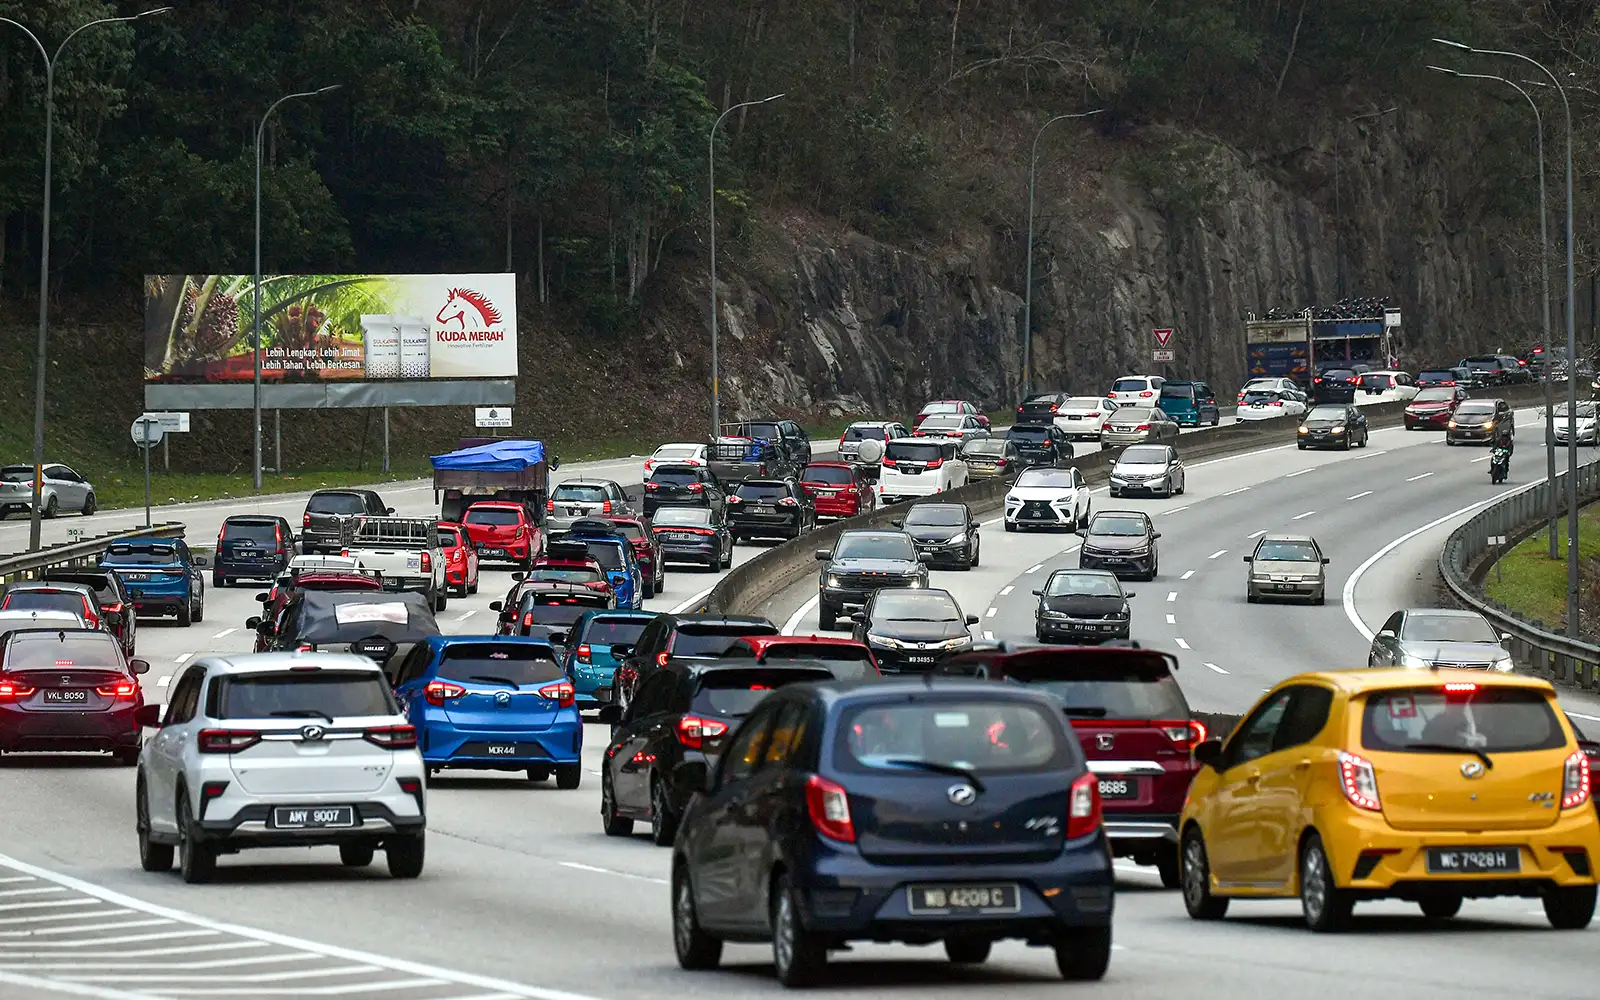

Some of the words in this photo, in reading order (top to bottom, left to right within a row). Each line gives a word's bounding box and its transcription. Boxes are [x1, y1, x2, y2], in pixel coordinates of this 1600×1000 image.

[436, 331, 467, 342] KUDA
[469, 331, 504, 341] MERAH
[266, 347, 285, 357] Lebih
[320, 347, 339, 357] Lebih
[341, 347, 361, 357] Jimat
[262, 360, 281, 370] Lebih
[306, 360, 326, 370] Lebih
[327, 360, 361, 369] Berkesan
[504, 746, 515, 754] 441
[1098, 780, 1127, 794] 8685
[289, 811, 307, 822] AMY
[313, 810, 339, 822] 9007
[1440, 852, 1459, 868] WC
[1460, 851, 1495, 868] 7928
[1496, 851, 1507, 867] H
[949, 888, 990, 907] 4209
[990, 888, 1004, 906] C
